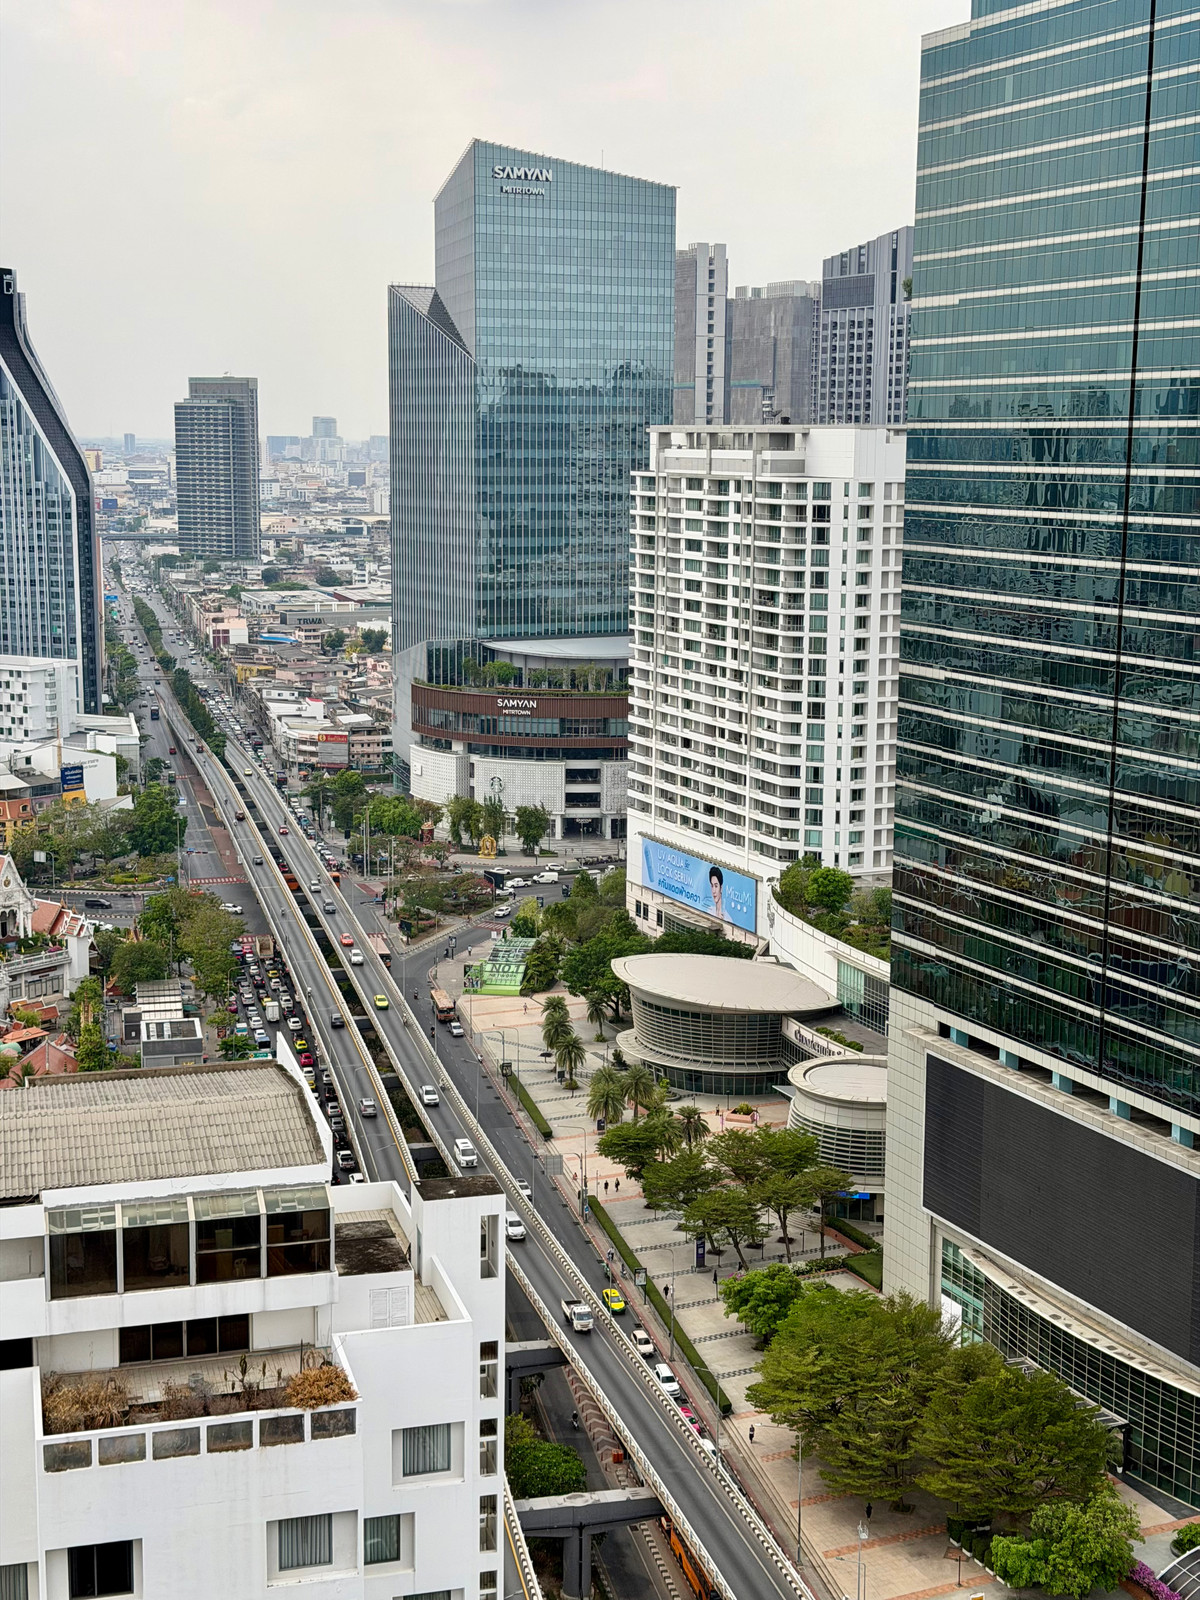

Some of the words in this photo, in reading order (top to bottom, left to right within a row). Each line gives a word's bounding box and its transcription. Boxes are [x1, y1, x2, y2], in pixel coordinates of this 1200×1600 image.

[492, 165, 553, 182] SAMYAN
[501, 185, 545, 196] MITRTOWN
[497, 698, 537, 708] SAMYAN
[667, 853, 685, 869] AQUA
[657, 863, 674, 881] LOCK
[673, 869, 695, 888] SERUM
[725, 885, 753, 907] MizuMi
